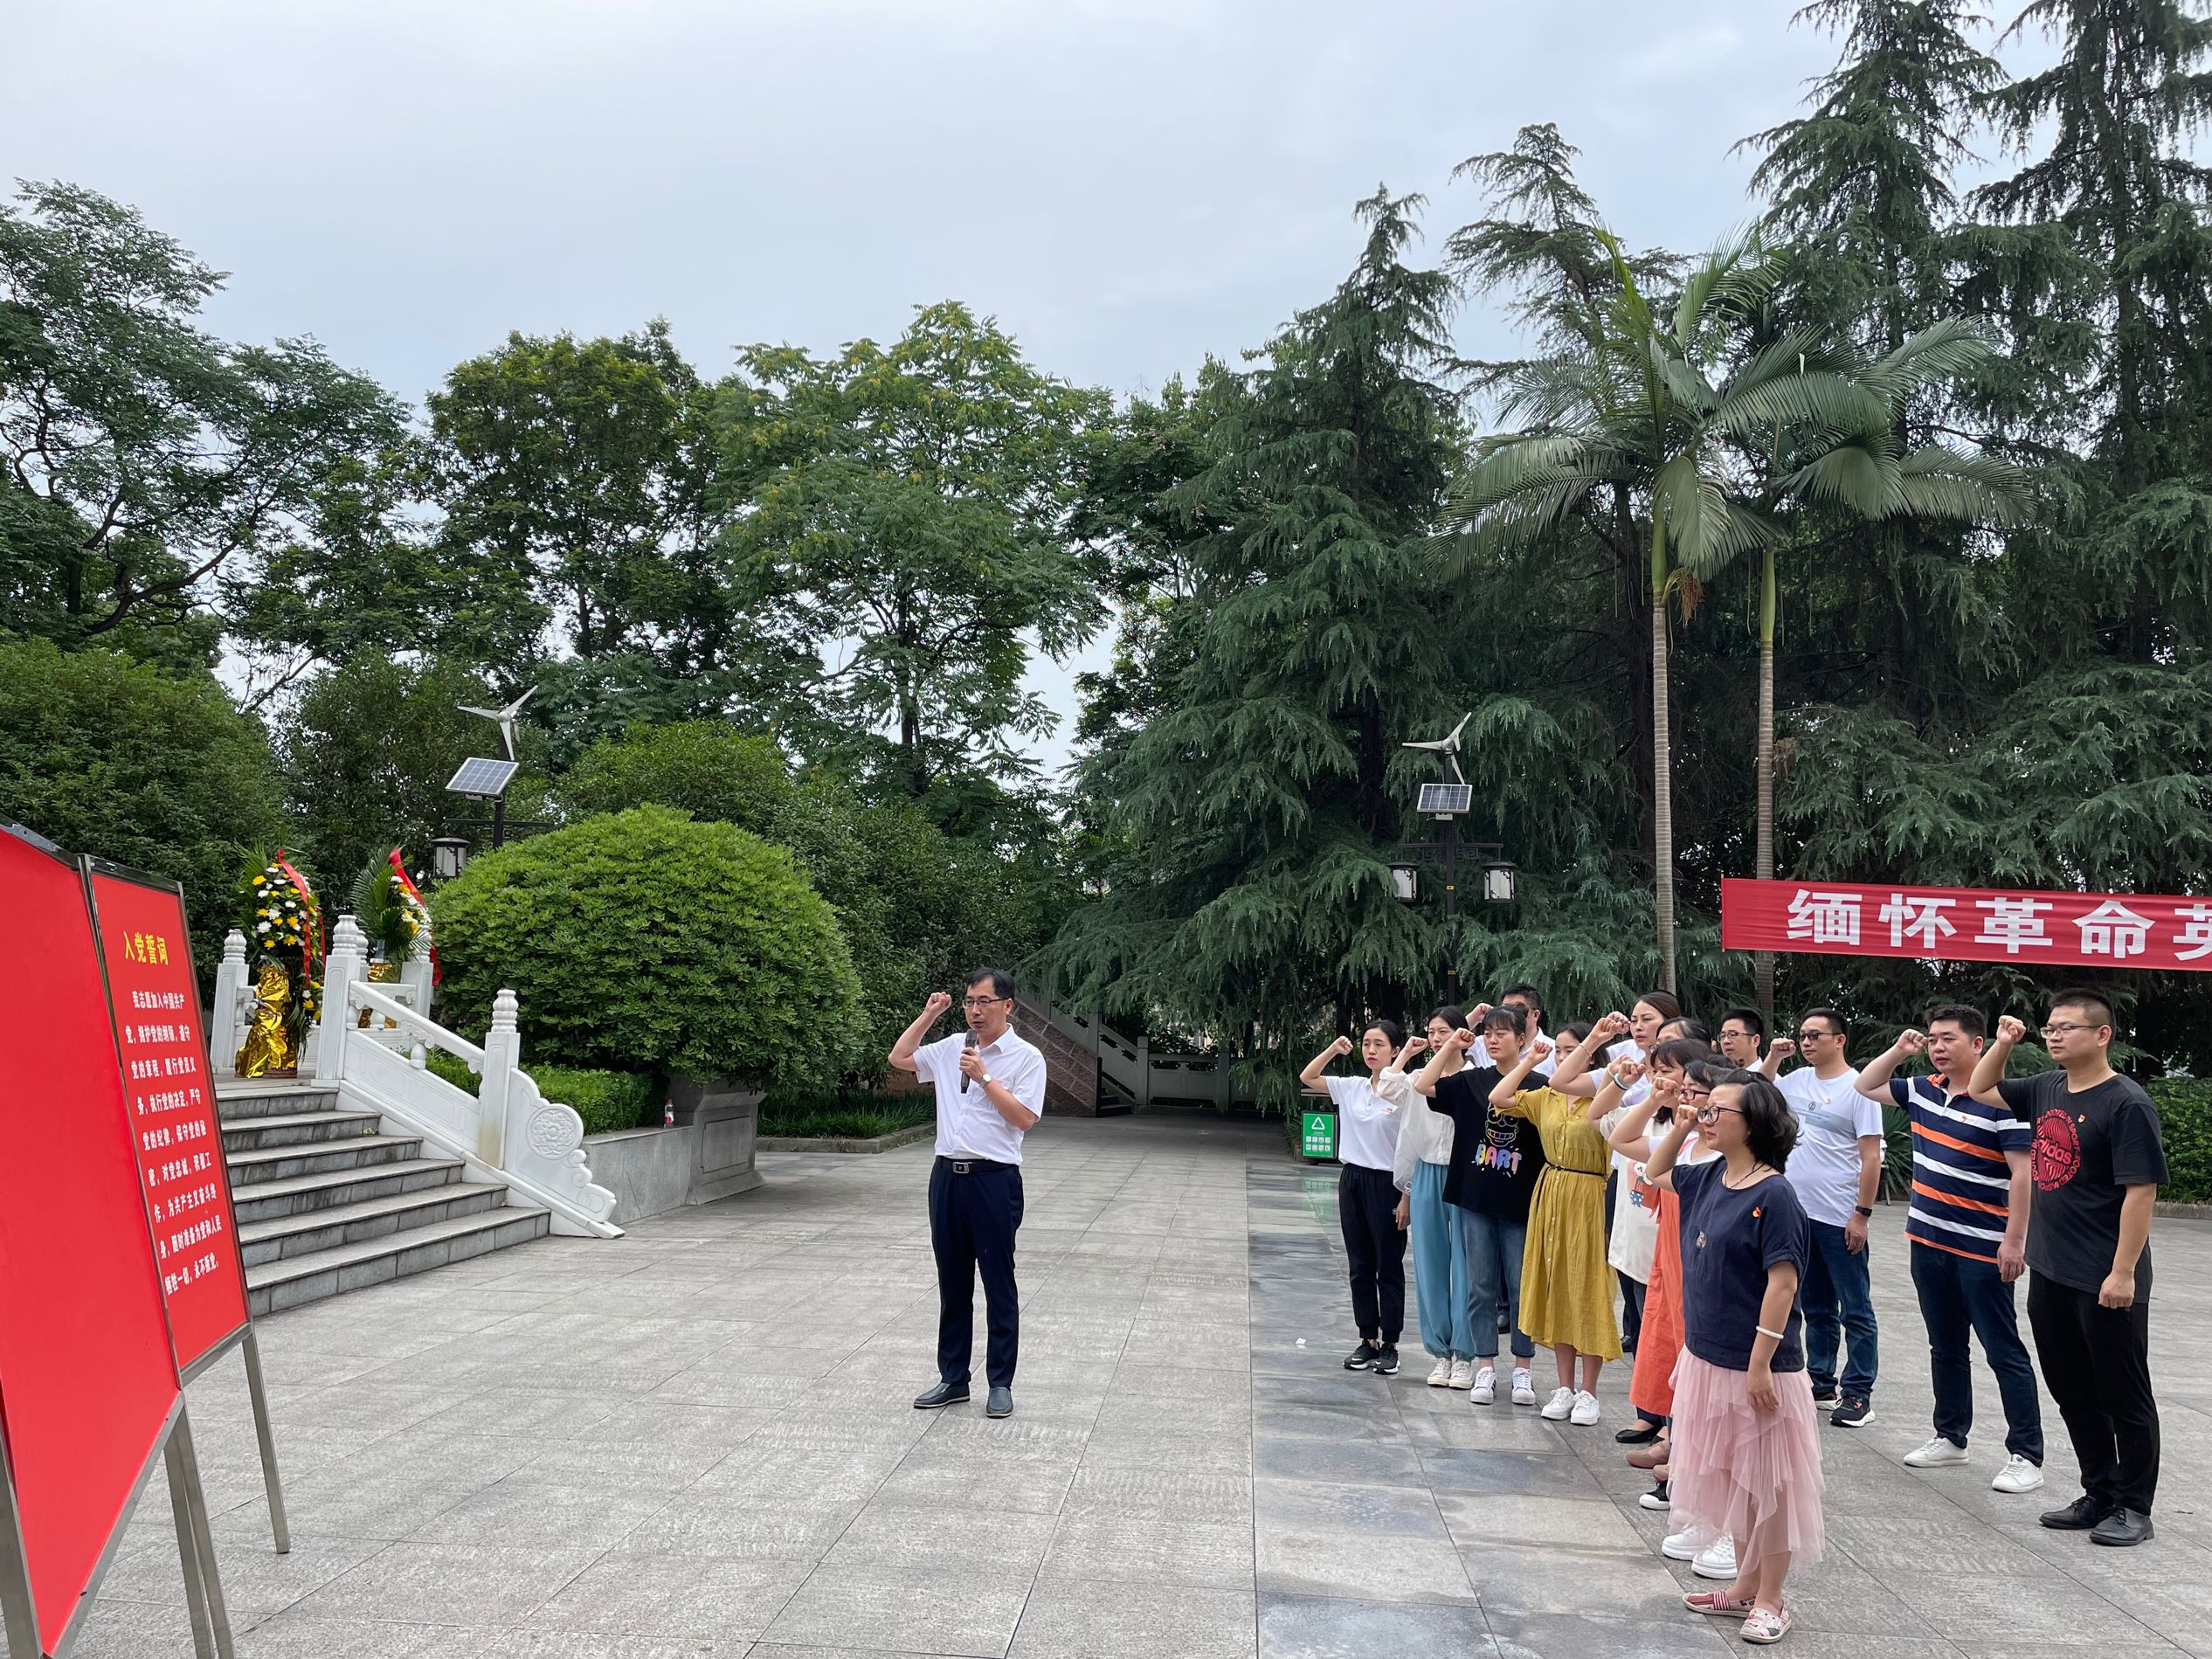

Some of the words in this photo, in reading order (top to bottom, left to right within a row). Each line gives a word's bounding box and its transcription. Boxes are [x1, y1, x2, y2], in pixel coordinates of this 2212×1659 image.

[123, 931, 168, 964] 入党誓词
[131, 991, 184, 1009] 我志愿加入中国共产
[1475, 1144, 1522, 1175] BART
[2038, 1139, 2072, 1165] didas
